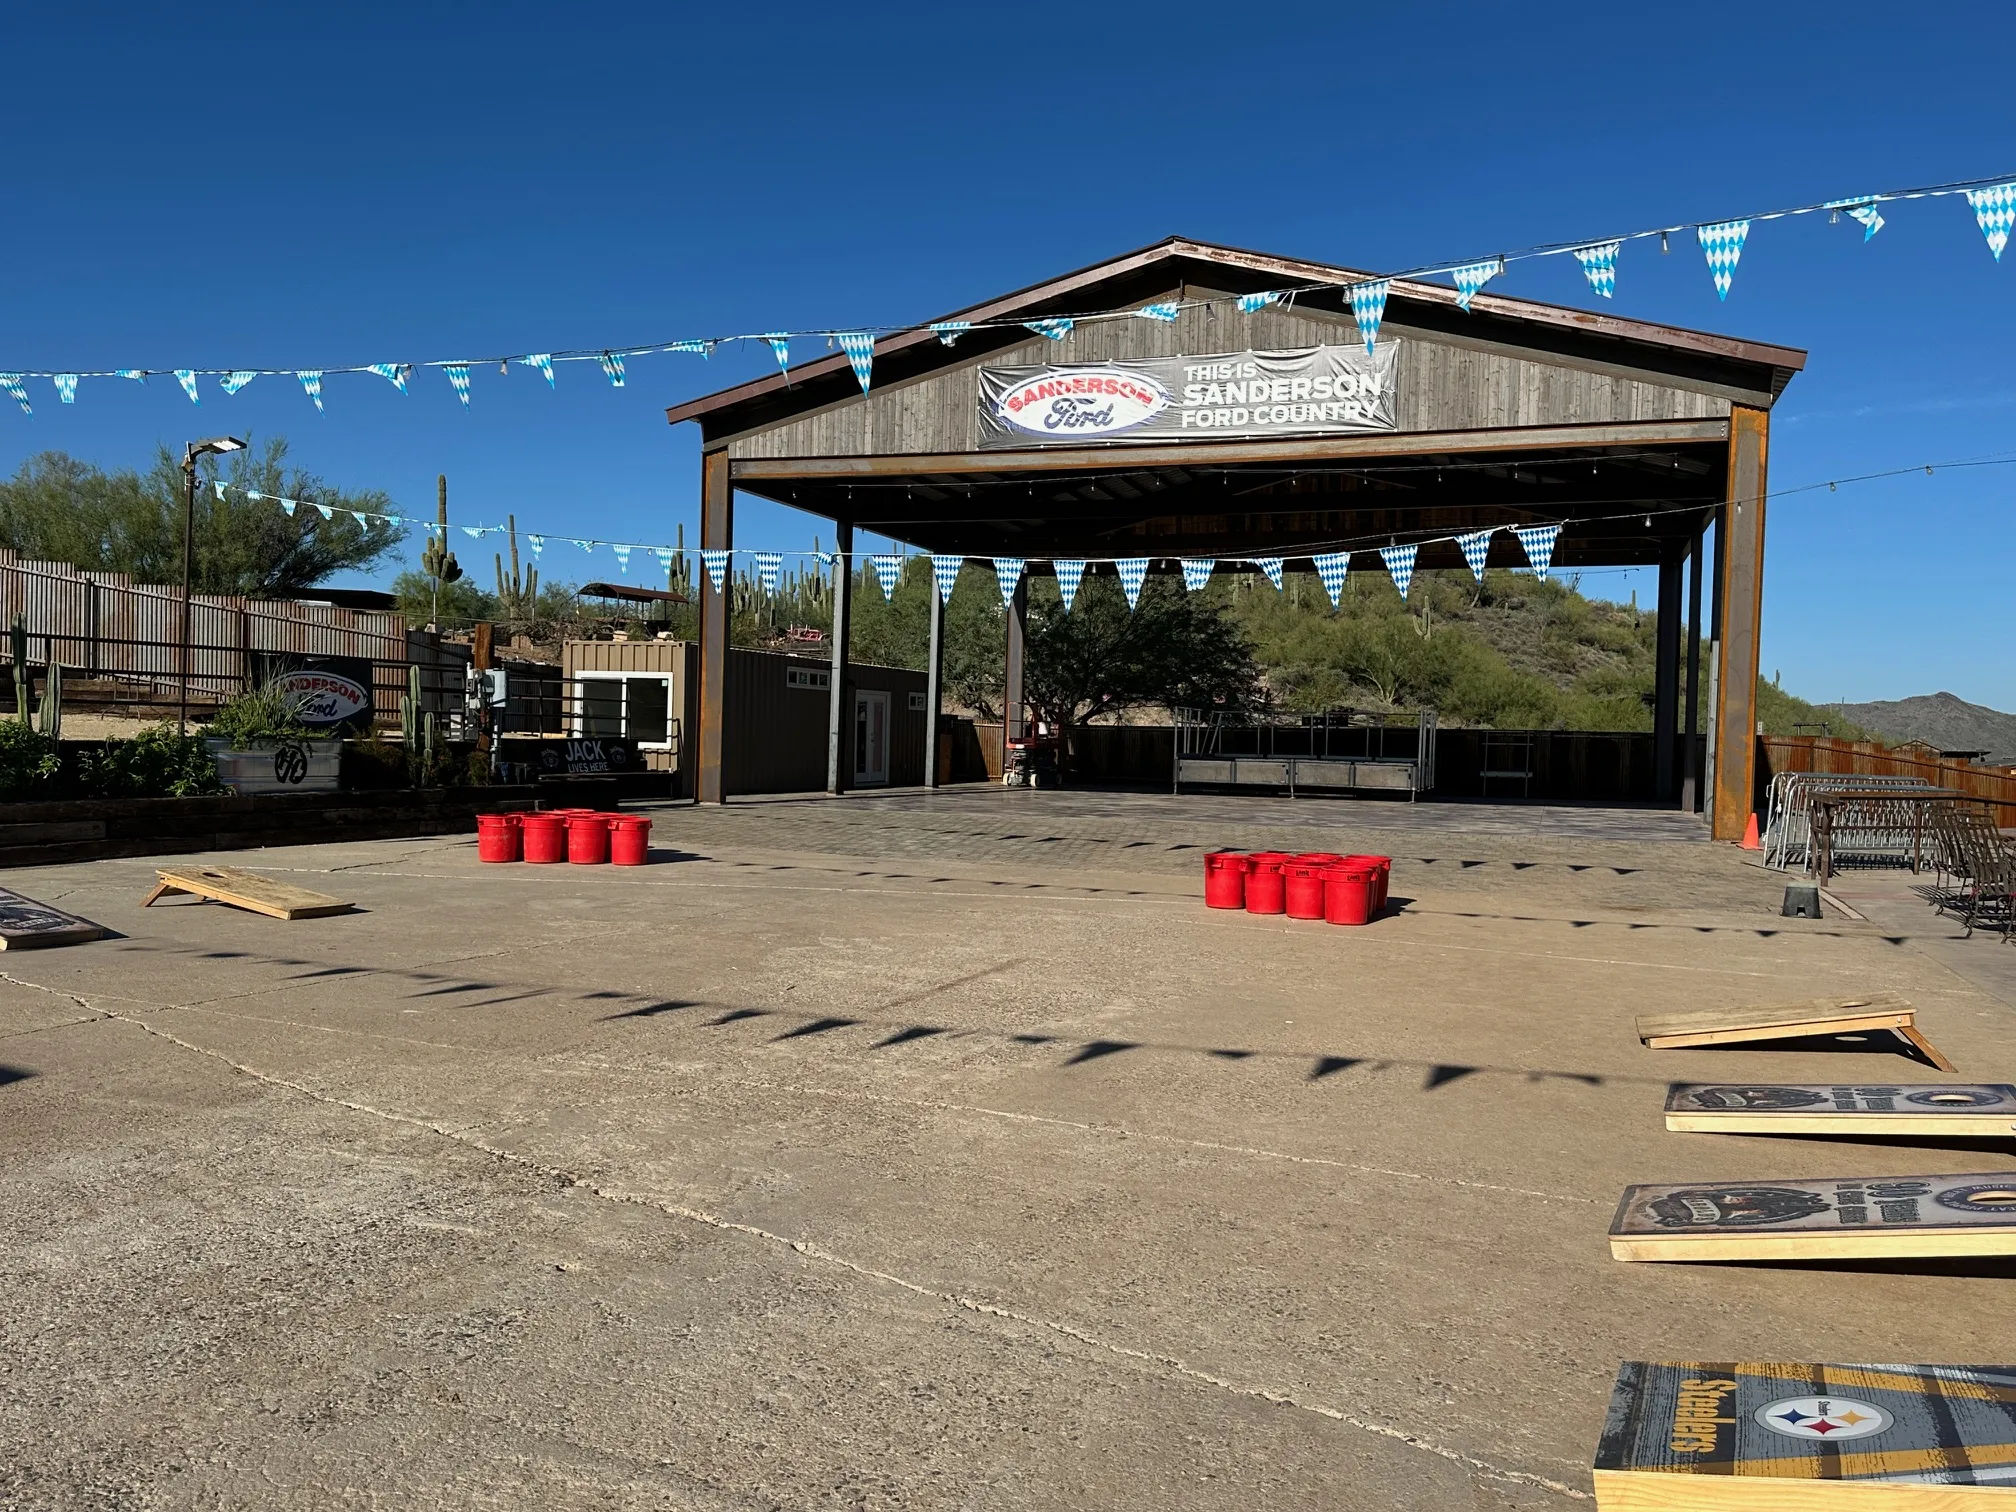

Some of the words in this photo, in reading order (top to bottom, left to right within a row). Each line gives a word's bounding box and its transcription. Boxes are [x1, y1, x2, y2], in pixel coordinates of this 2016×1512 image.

[1183, 364, 1231, 381] THIS
[1235, 362, 1257, 379] IS
[1007, 377, 1156, 413] SANDERSON
[1181, 372, 1382, 408] SANDERSON
[1043, 398, 1114, 430] Ford
[1181, 406, 1250, 429] FORD
[1254, 399, 1381, 426] COUNTRY
[565, 740, 606, 762] JACK
[567, 763, 588, 773] LIVES
[1670, 1378, 1738, 1452] Steelers
